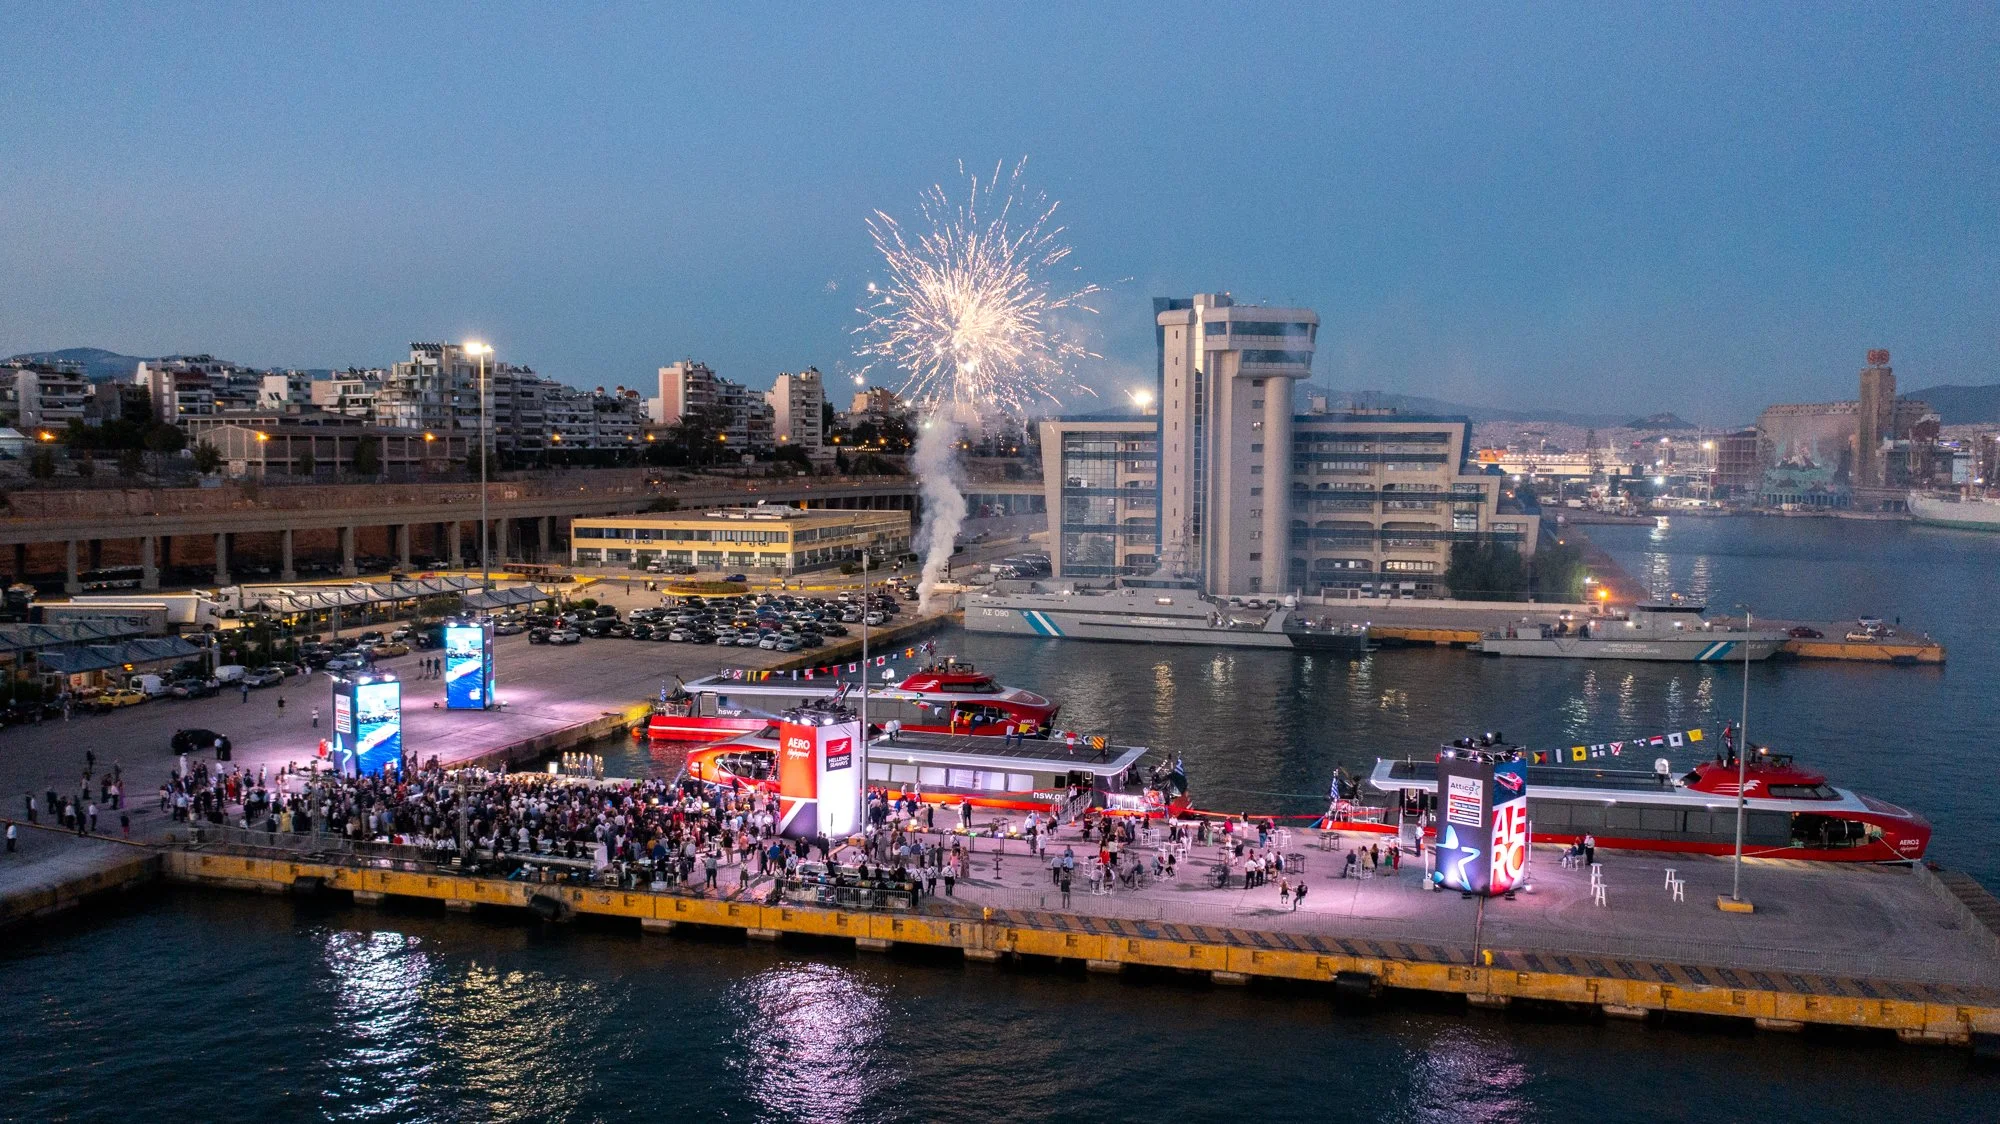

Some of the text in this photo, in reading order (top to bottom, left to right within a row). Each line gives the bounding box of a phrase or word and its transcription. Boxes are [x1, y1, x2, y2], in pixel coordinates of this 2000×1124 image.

[994, 609, 1010, 618] 090
[718, 708, 742, 717] hsw.gr
[787, 737, 811, 750] AERO
[828, 755, 850, 763] HELLENIC
[1033, 791, 1066, 803] hsw.gr
